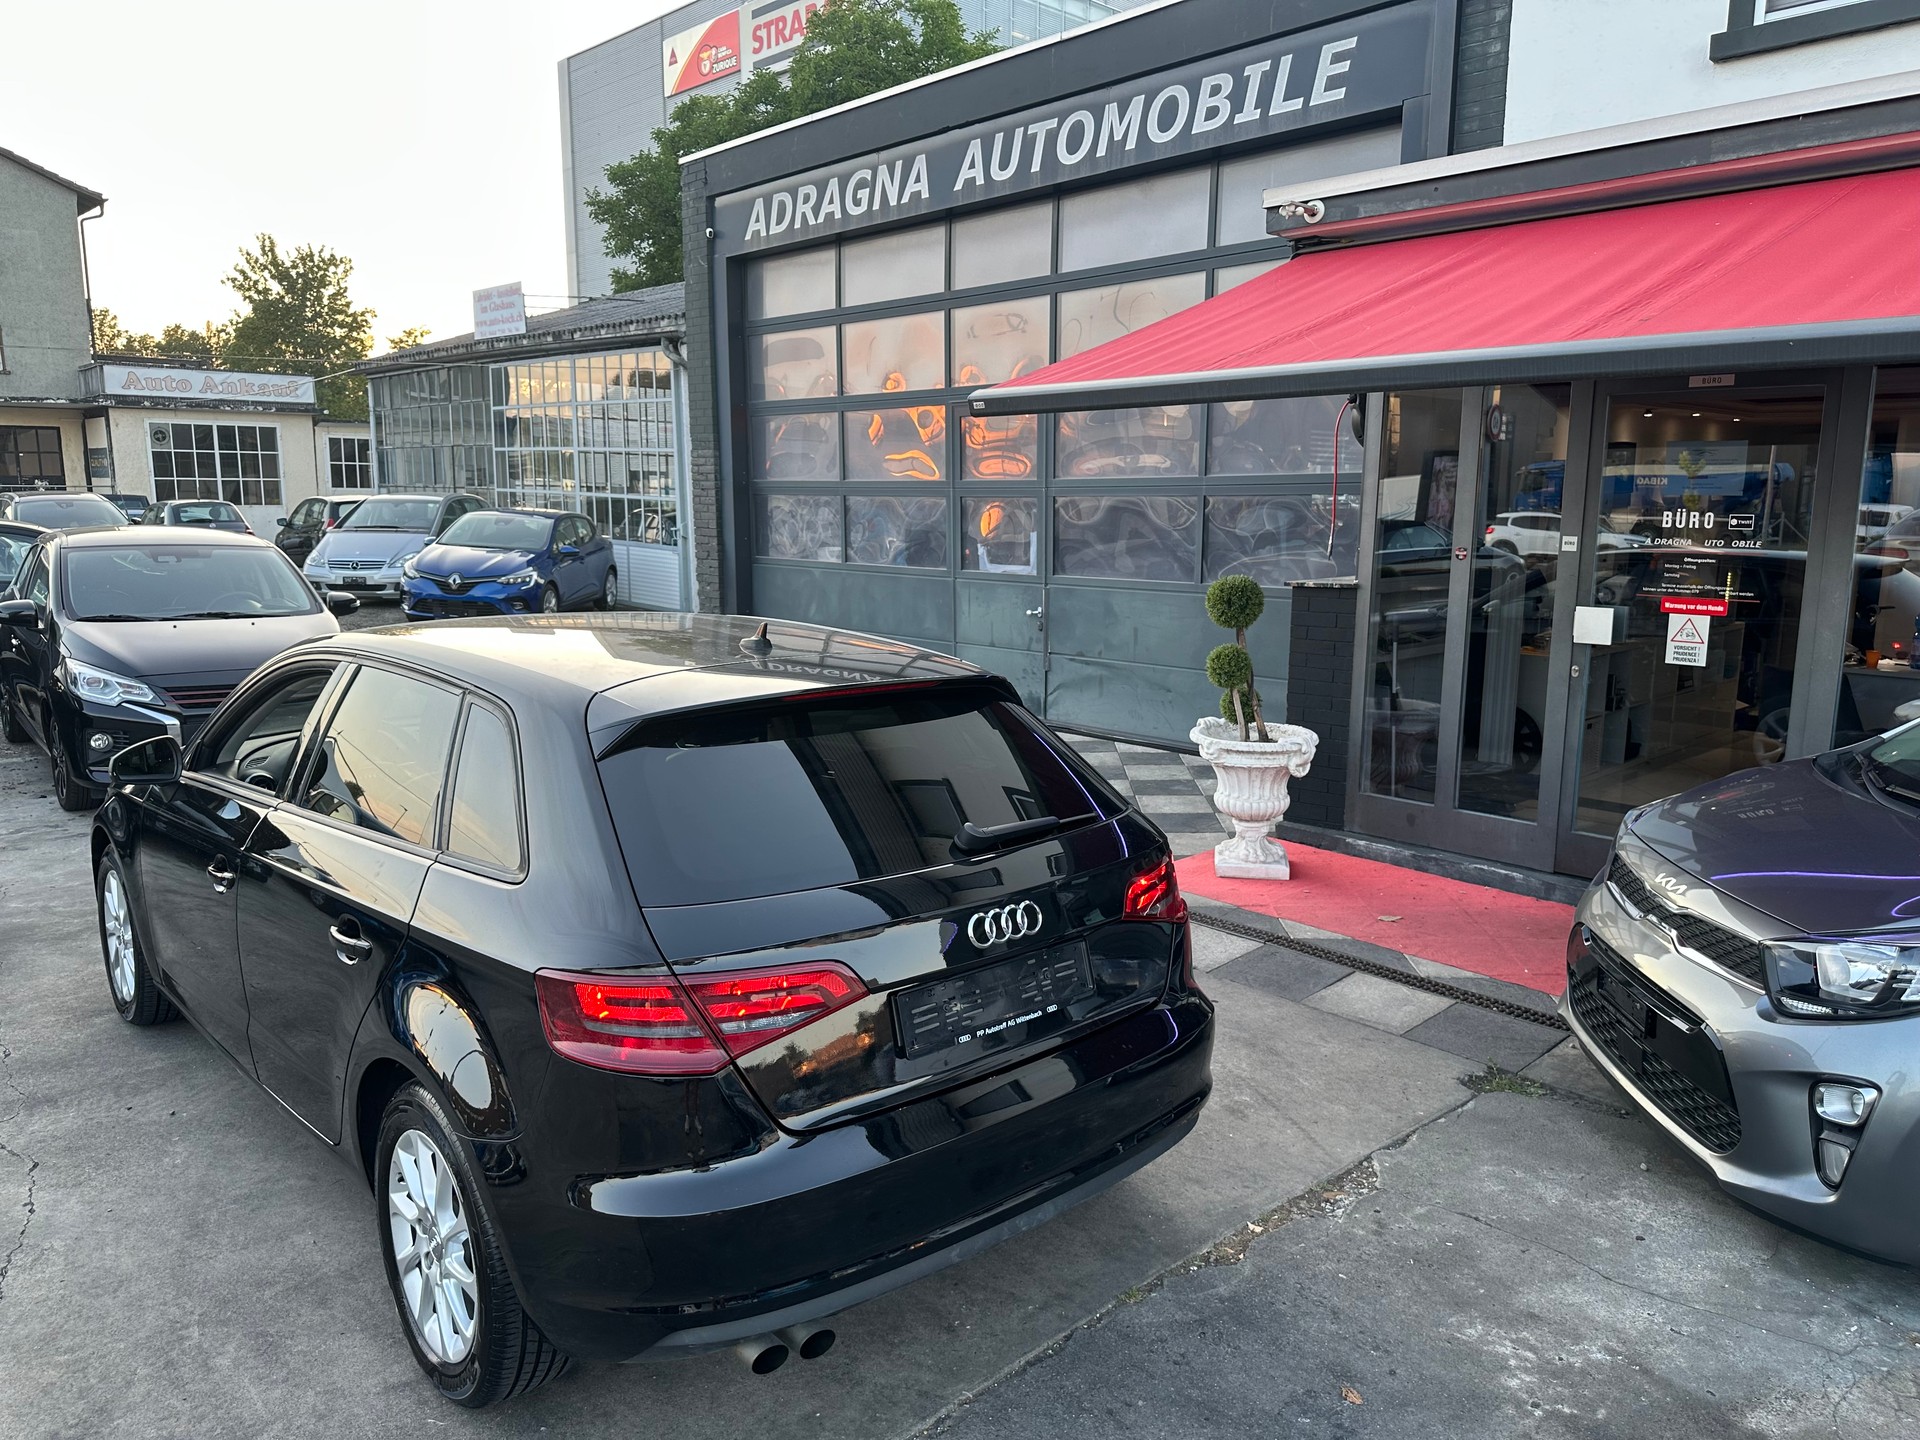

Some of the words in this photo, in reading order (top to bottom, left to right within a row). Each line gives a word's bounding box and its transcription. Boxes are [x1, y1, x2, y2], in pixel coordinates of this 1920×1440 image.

[712, 56, 738, 74] ZURIQUE
[744, 153, 931, 241] ADRAGNA
[952, 35, 1359, 192] AUTOMOBILE
[489, 299, 516, 312] Glashaus
[121, 370, 193, 393] Auto
[199, 375, 300, 398] Ankauf
[1701, 376, 1722, 385] BÜRO
[1661, 508, 1715, 529] BÜRO
[1731, 540, 1763, 549] OBILE
[1664, 601, 1687, 610] Warnung
[1696, 603, 1708, 611] dem
[1708, 604, 1724, 612] Hunde
[1654, 872, 1688, 895] KIA
[976, 1029, 985, 1038] PP
[985, 1021, 1007, 1035] Autotreff
[1007, 1018, 1016, 1027] AG
